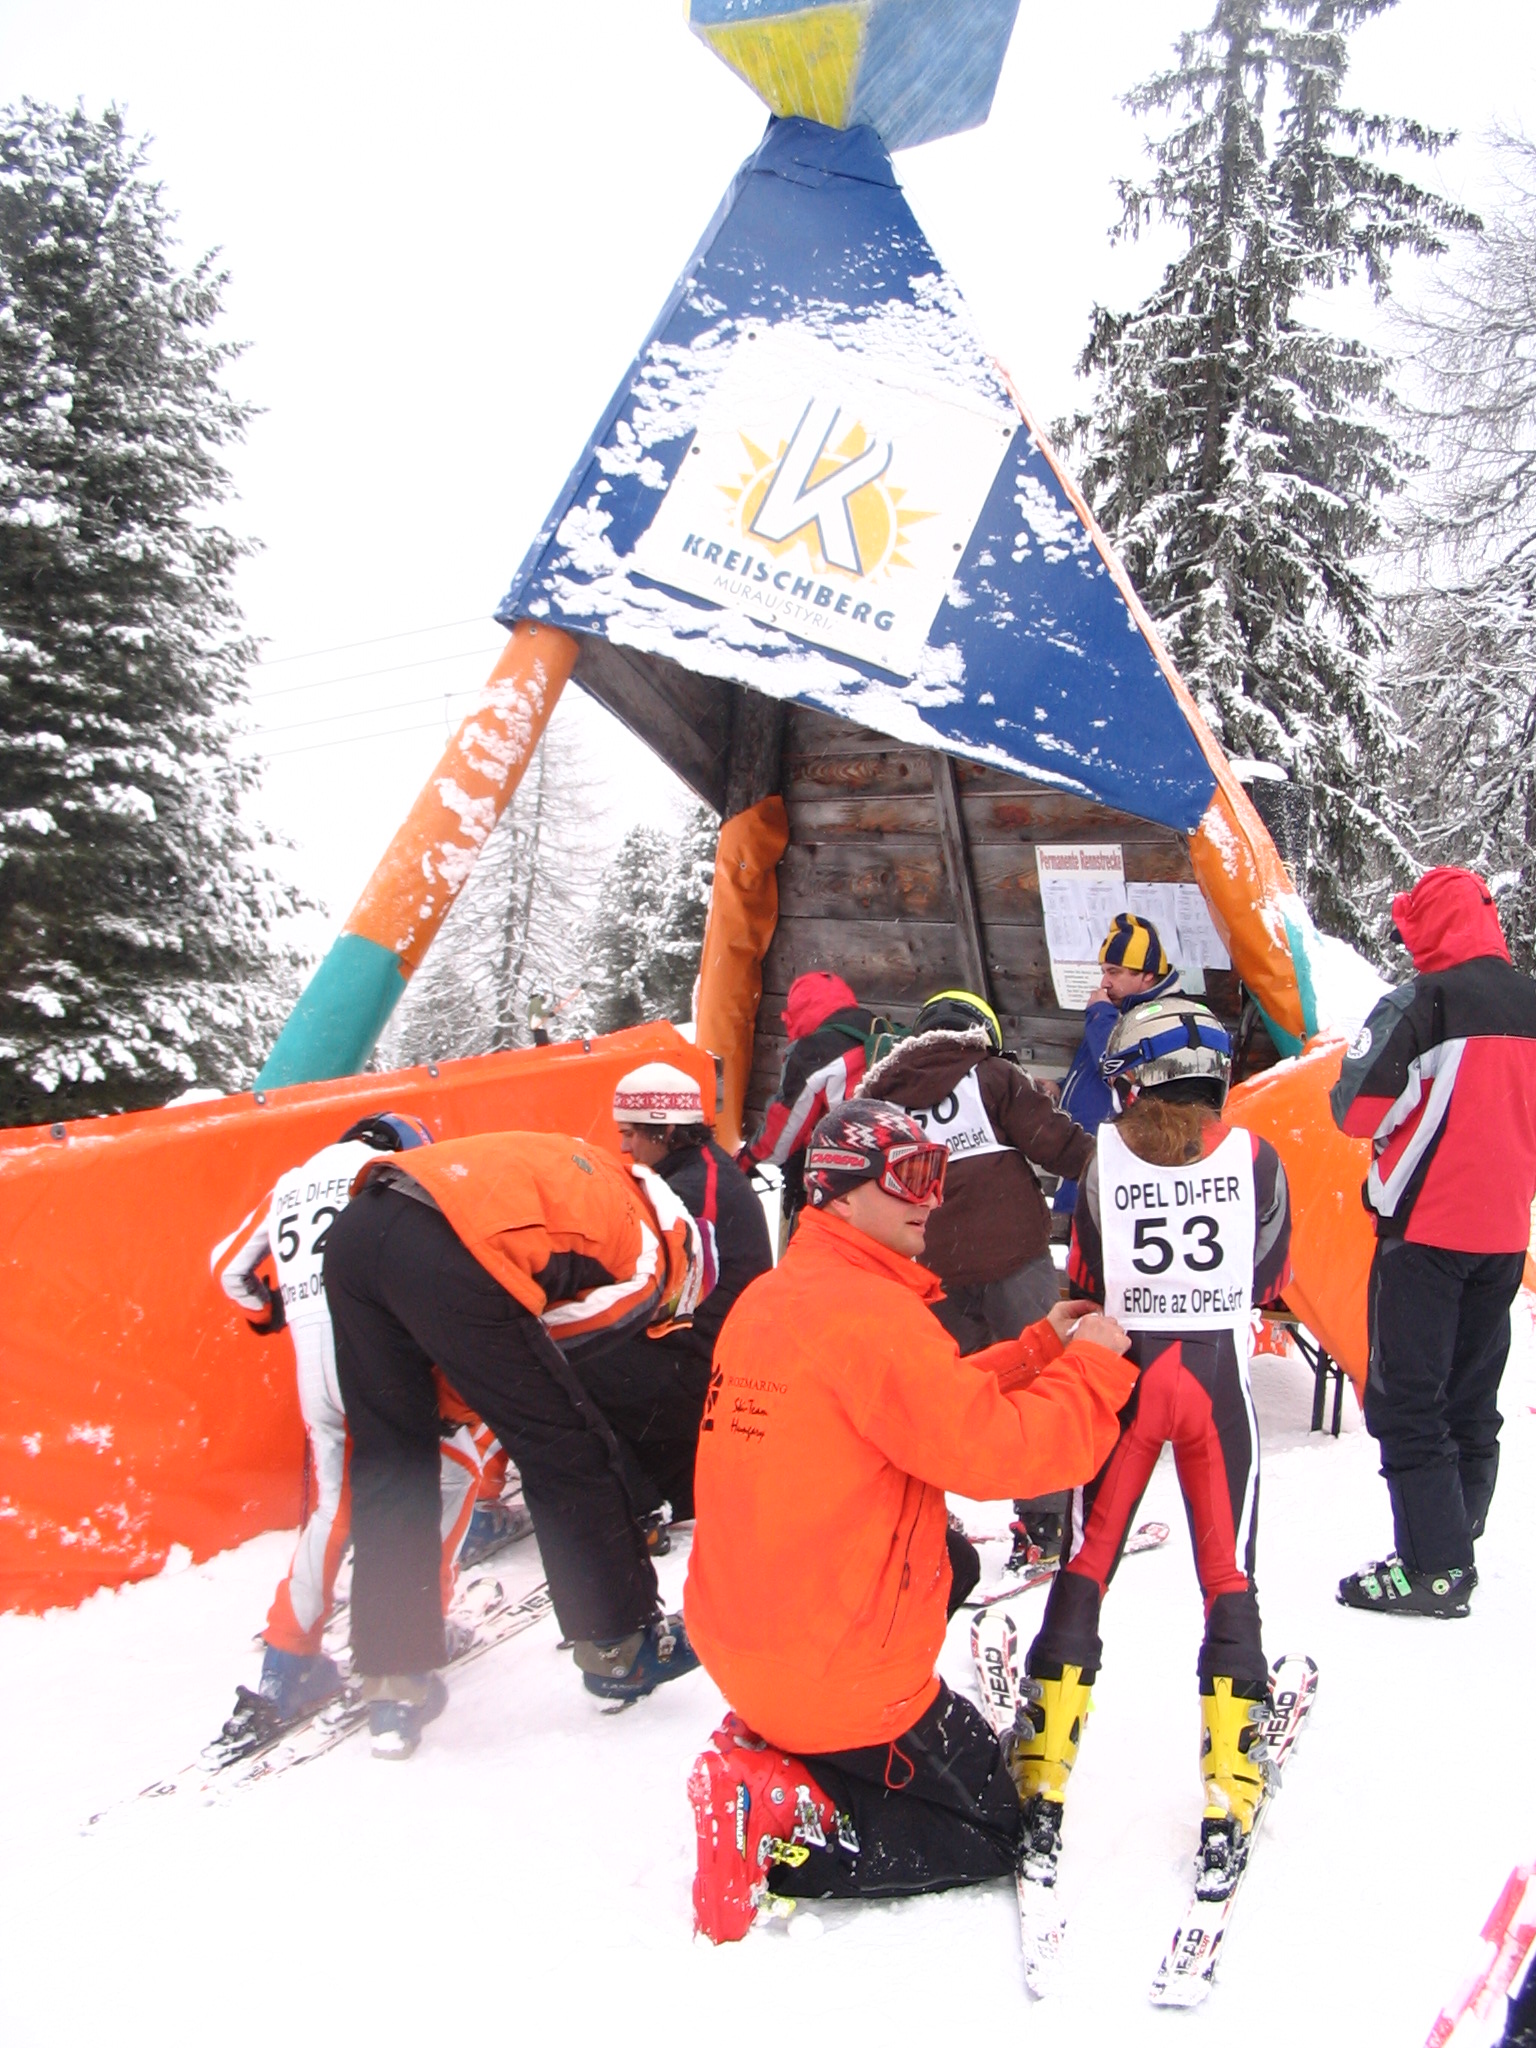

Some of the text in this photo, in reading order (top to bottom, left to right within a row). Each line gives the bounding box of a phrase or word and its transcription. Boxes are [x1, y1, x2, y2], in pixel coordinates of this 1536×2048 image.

[682, 533, 896, 632] KREISCHBERG
[1115, 1176, 1240, 1210] OPEL DI-FER
[278, 1206, 340, 1263] 52
[1132, 1215, 1224, 1275] 53
[1171, 1293, 1187, 1314] az
[984, 1647, 1013, 1710] HEAD
[1266, 1691, 1298, 1746] HEAD
[736, 1784, 744, 1850] SALOMON
